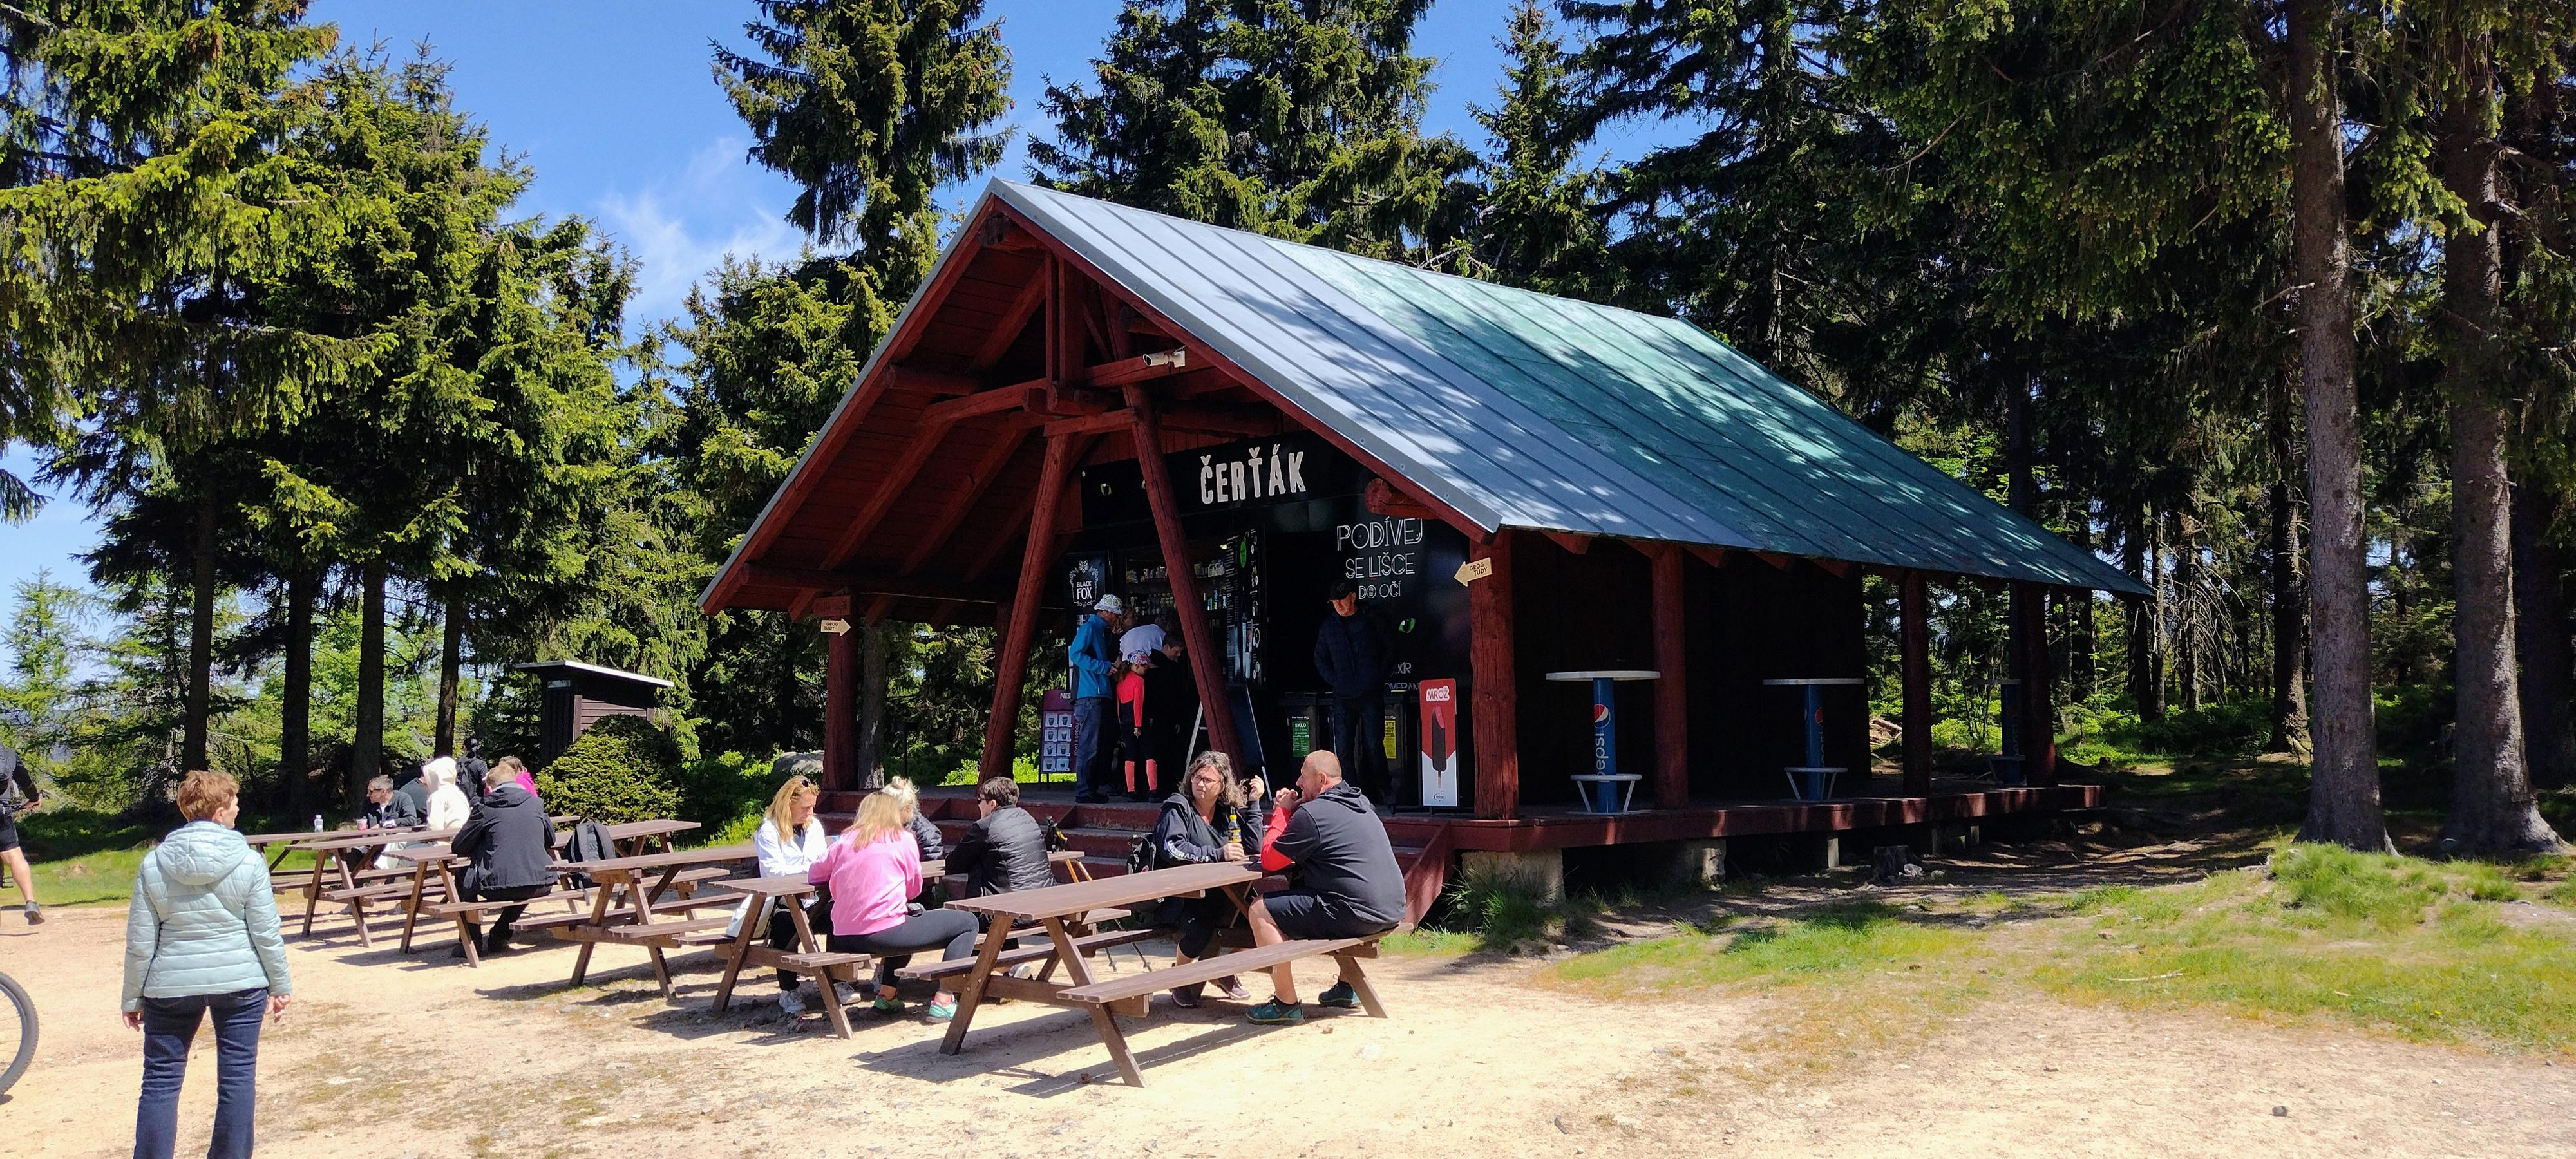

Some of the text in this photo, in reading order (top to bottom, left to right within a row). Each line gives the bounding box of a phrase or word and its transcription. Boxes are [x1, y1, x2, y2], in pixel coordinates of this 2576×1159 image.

[1200, 443, 1306, 505] ČERŤÁK
[1337, 516, 1423, 551] PODÍVEJ
[1345, 551, 1415, 578] SE LIŠCE
[1469, 562, 1484, 571] GROG
[1473, 567, 1487, 576] TUDY
[1076, 587, 1092, 600] FOX
[1359, 580, 1401, 599] DO OČÍ
[1427, 686, 1449, 701] MROŽ
